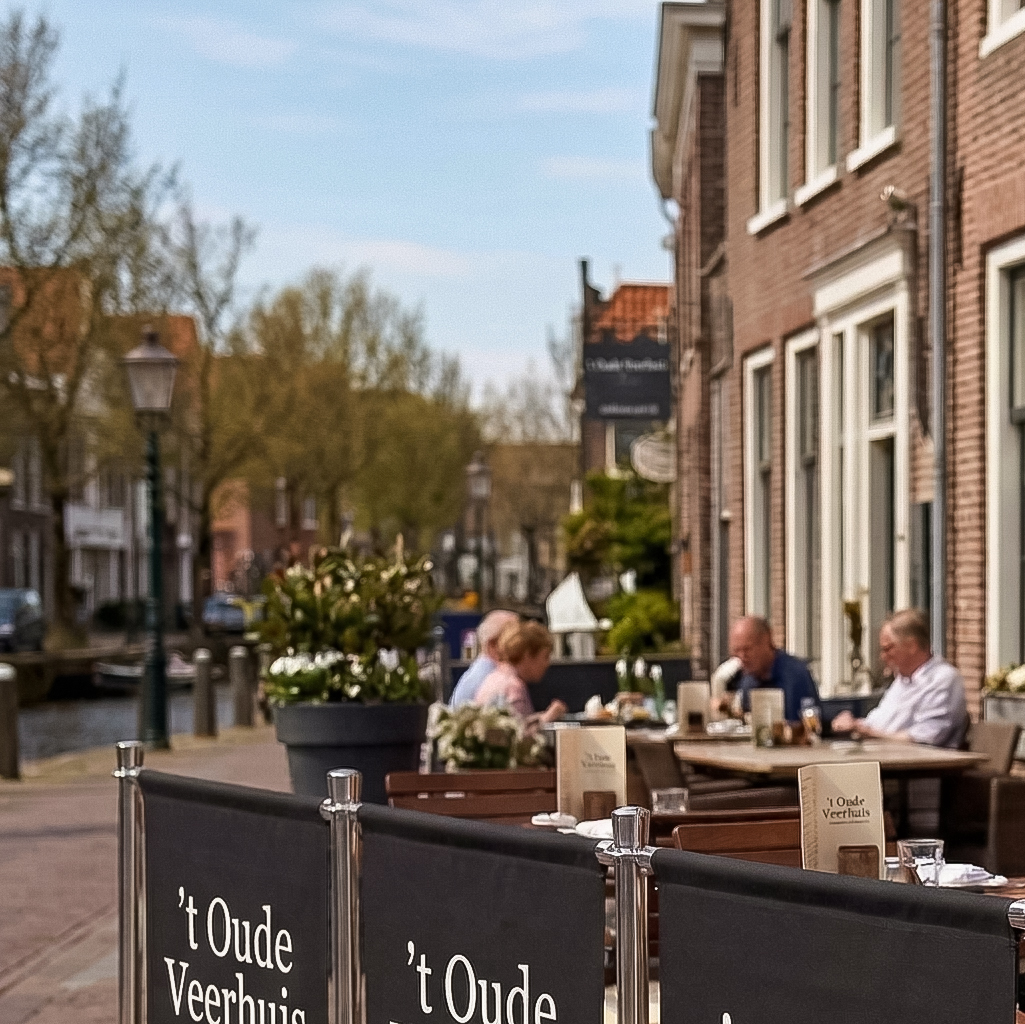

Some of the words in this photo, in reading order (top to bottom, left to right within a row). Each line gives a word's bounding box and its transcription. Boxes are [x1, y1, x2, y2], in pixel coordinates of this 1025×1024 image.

[179, 887, 198, 950] ’t
[207, 897, 292, 973] Oude
[408, 941, 432, 1013] ’t
